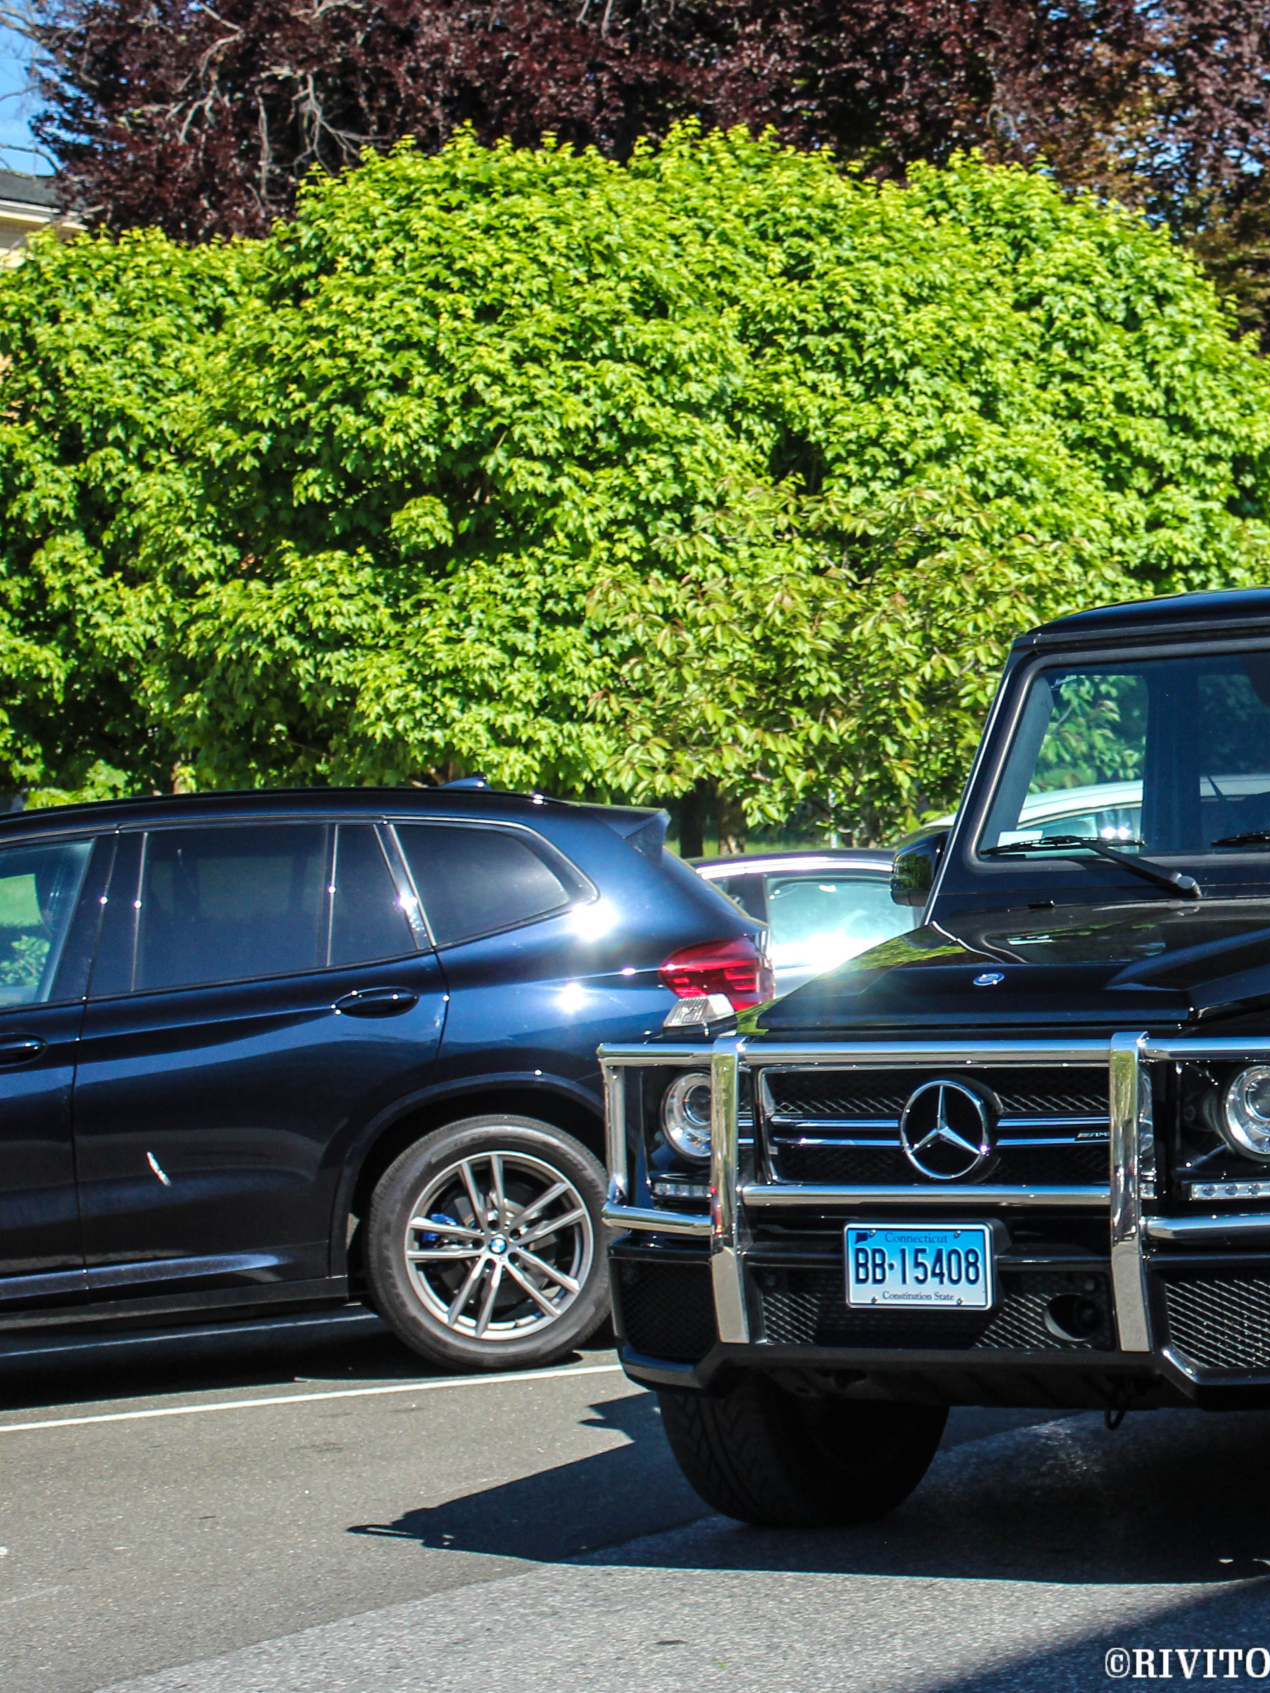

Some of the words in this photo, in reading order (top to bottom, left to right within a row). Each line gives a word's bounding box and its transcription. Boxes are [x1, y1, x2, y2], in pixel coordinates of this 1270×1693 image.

[885, 1232, 948, 1244] Connecticut
[882, 1291, 932, 1301] Constitution
[934, 1292, 955, 1301] State
